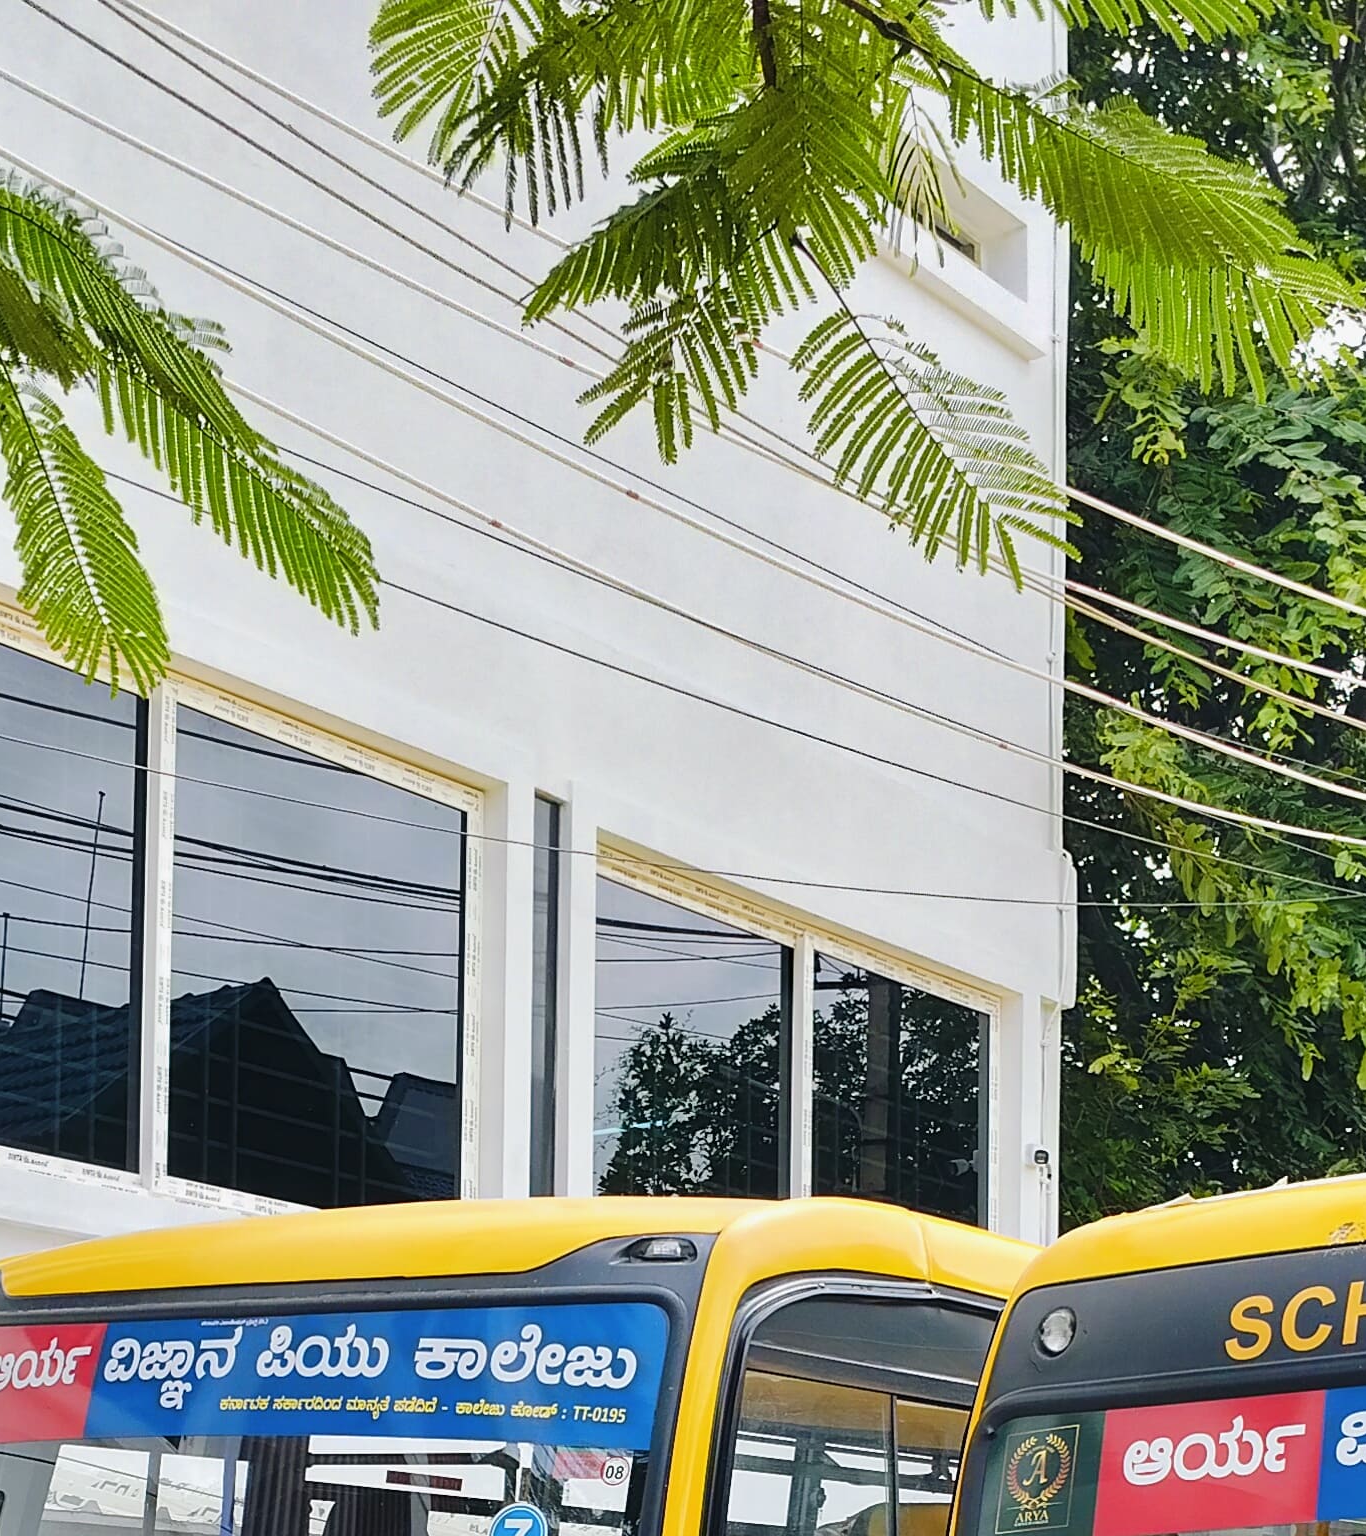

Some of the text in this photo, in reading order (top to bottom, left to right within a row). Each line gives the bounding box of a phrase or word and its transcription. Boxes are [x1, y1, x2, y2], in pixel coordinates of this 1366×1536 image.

[103, 1325, 243, 1410] ವಿಜ್ಞಾನ
[256, 1324, 390, 1378] ಪಿಯು
[413, 1323, 637, 1390] ಕಾಲೇಜು
[455, 1399, 505, 1417] ಕಾಲೇಜು
[573, 1405, 627, 1424] TT-0195
[1122, 1414, 1307, 1486] ಆರ್ಯ
[605, 1464, 625, 1481] 08
[1015, 1509, 1049, 1522] ARYA
